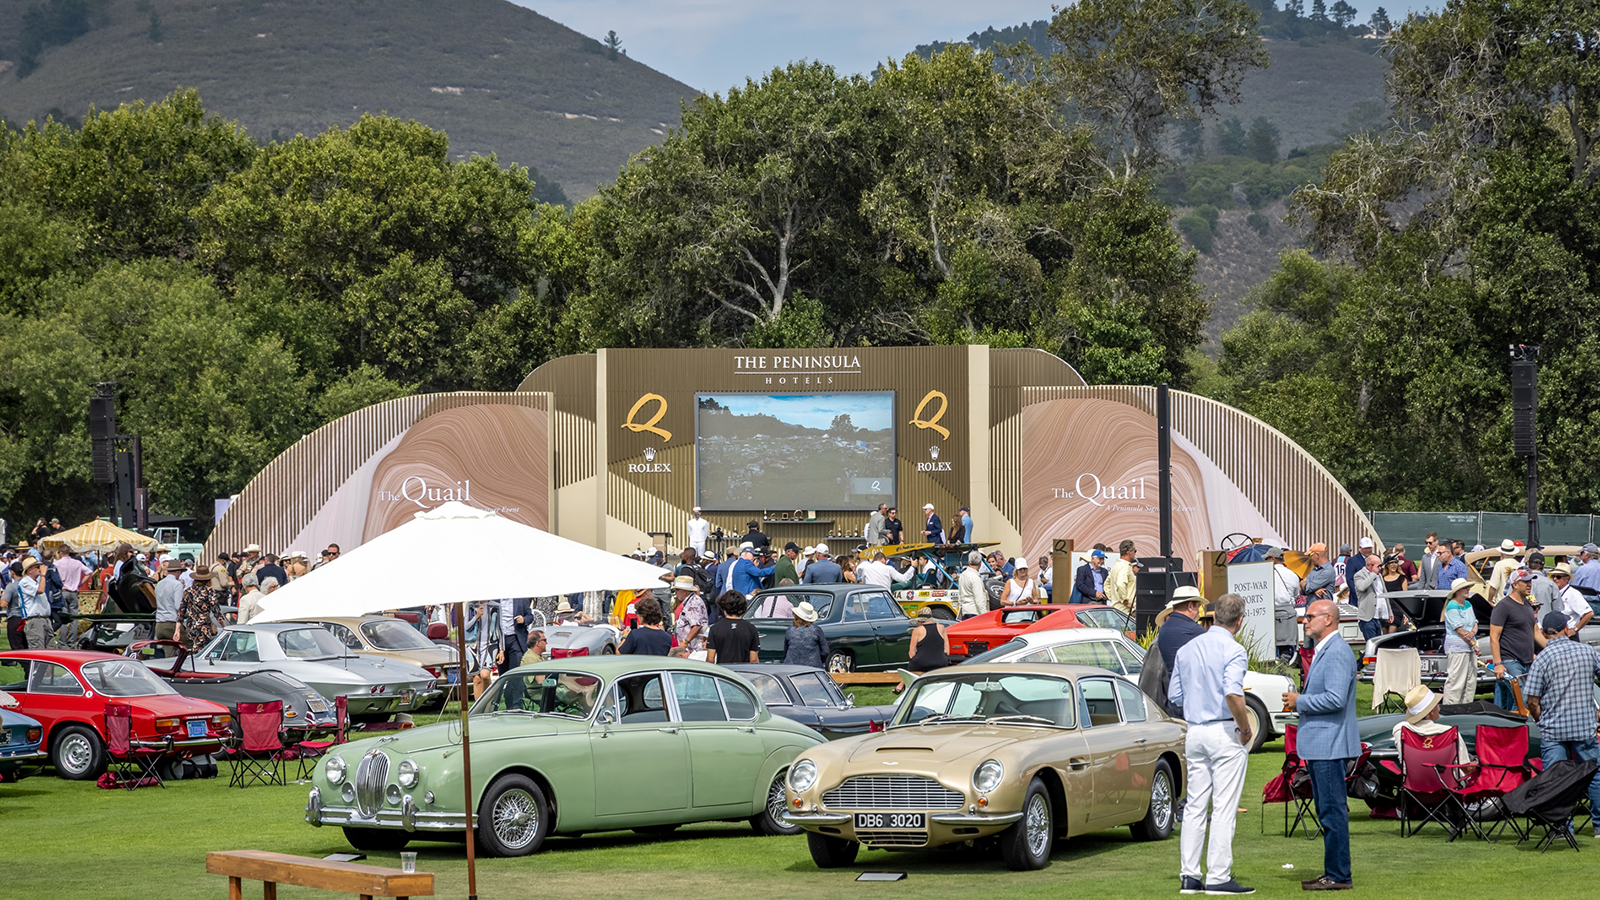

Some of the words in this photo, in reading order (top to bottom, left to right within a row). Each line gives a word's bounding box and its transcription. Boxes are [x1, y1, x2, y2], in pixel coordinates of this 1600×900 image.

[734, 356, 767, 369] THE
[773, 355, 861, 369] PENINSULA
[620, 392, 673, 443] Q
[908, 389, 951, 441] Q
[628, 463, 672, 473] ROLEX
[917, 462, 952, 472] ROLEX
[378, 491, 400, 501] The
[401, 476, 471, 509] Quail
[1051, 487, 1074, 499] The
[1075, 472, 1146, 507] Quail
[1335, 564, 1345, 576] 16
[1233, 580, 1268, 592] POST-WAR
[1242, 594, 1264, 605] PORTS
[1244, 607, 1267, 617] 1-1975
[858, 814, 883, 828] DB6
[890, 814, 921, 828] 3020
